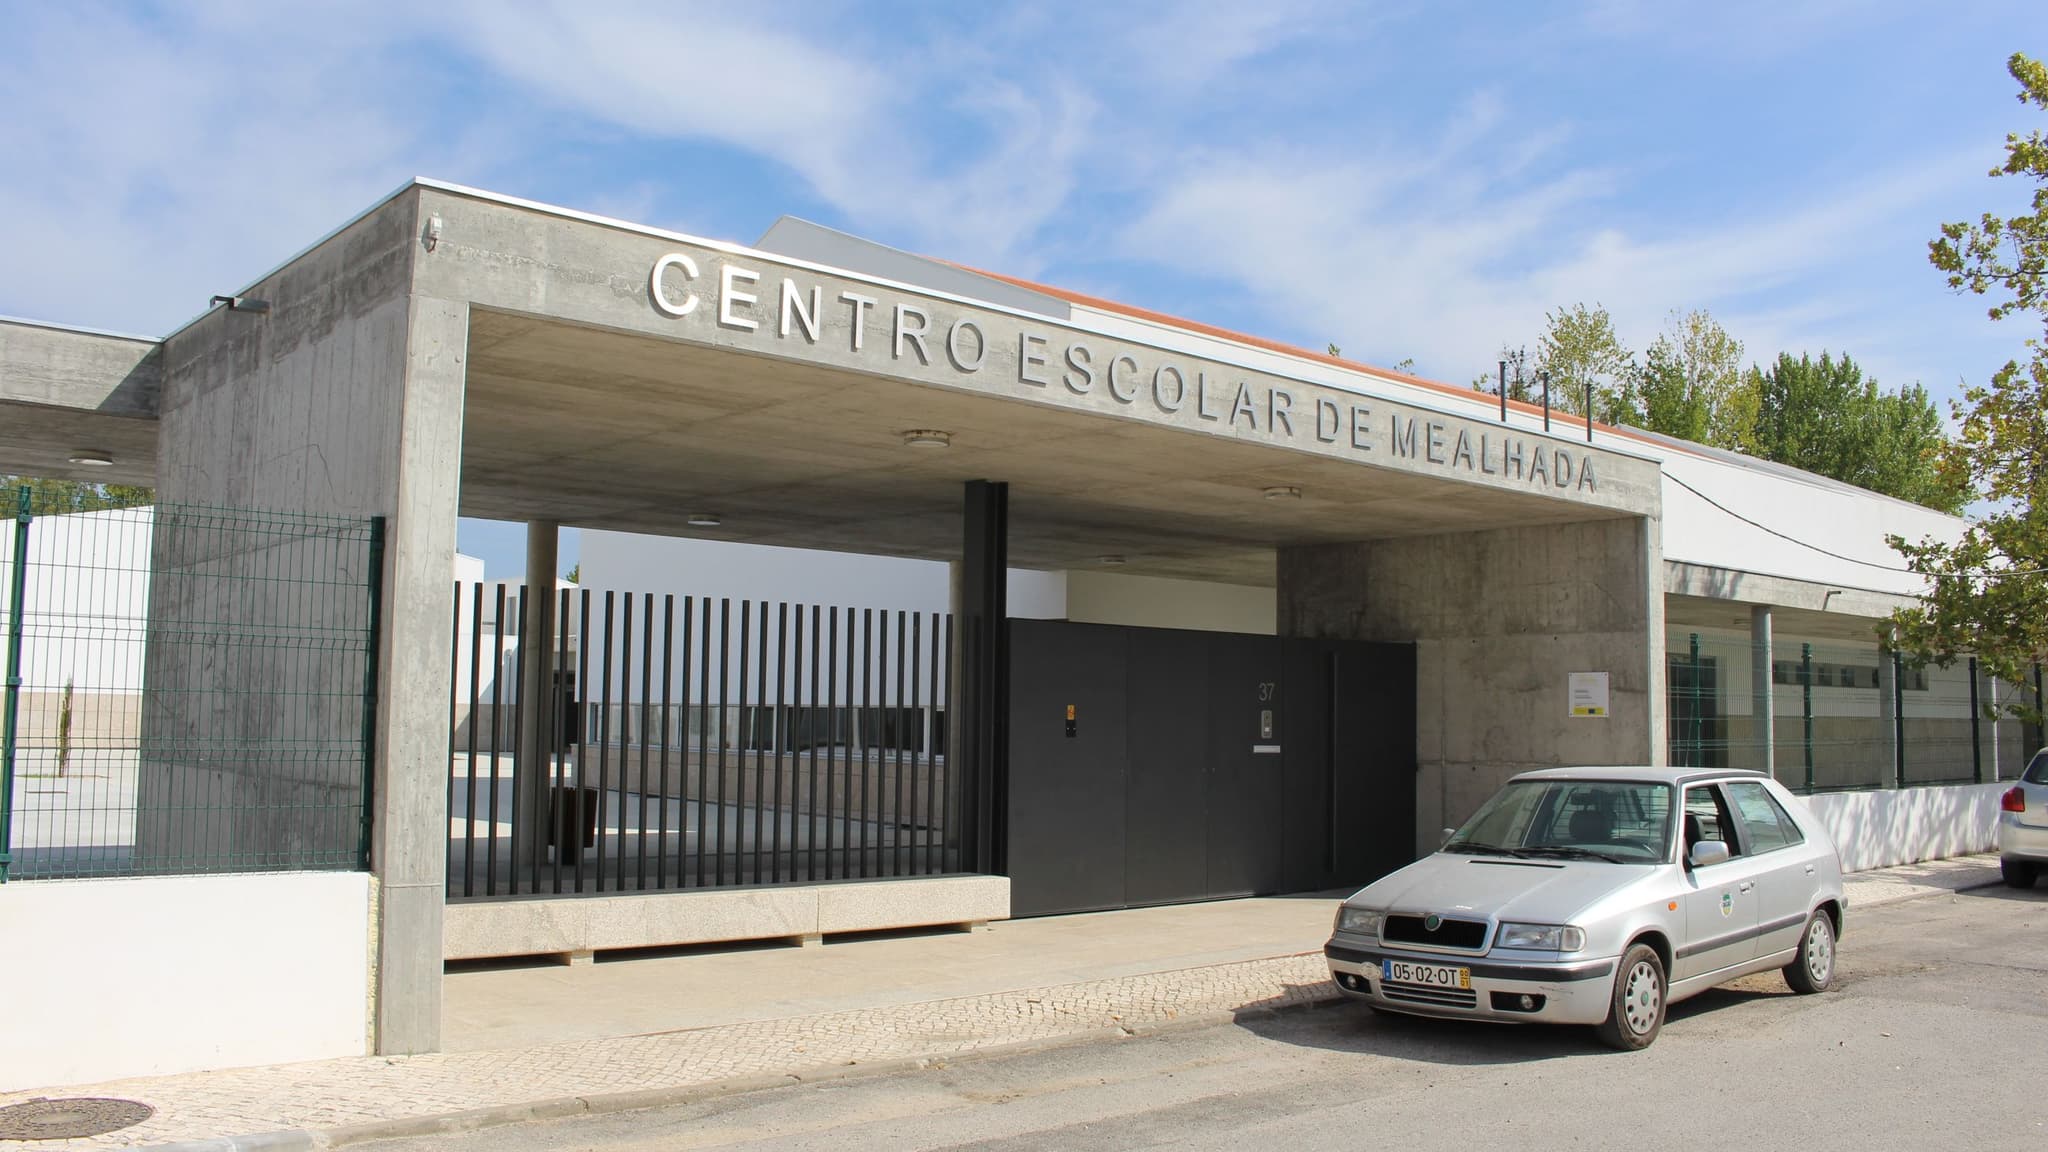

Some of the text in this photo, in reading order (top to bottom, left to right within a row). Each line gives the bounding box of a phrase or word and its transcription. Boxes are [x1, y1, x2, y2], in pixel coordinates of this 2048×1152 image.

[649, 252, 1598, 494] CENTRO ESCOLAR DE MEALHADA
[1258, 682, 1275, 701] 37
